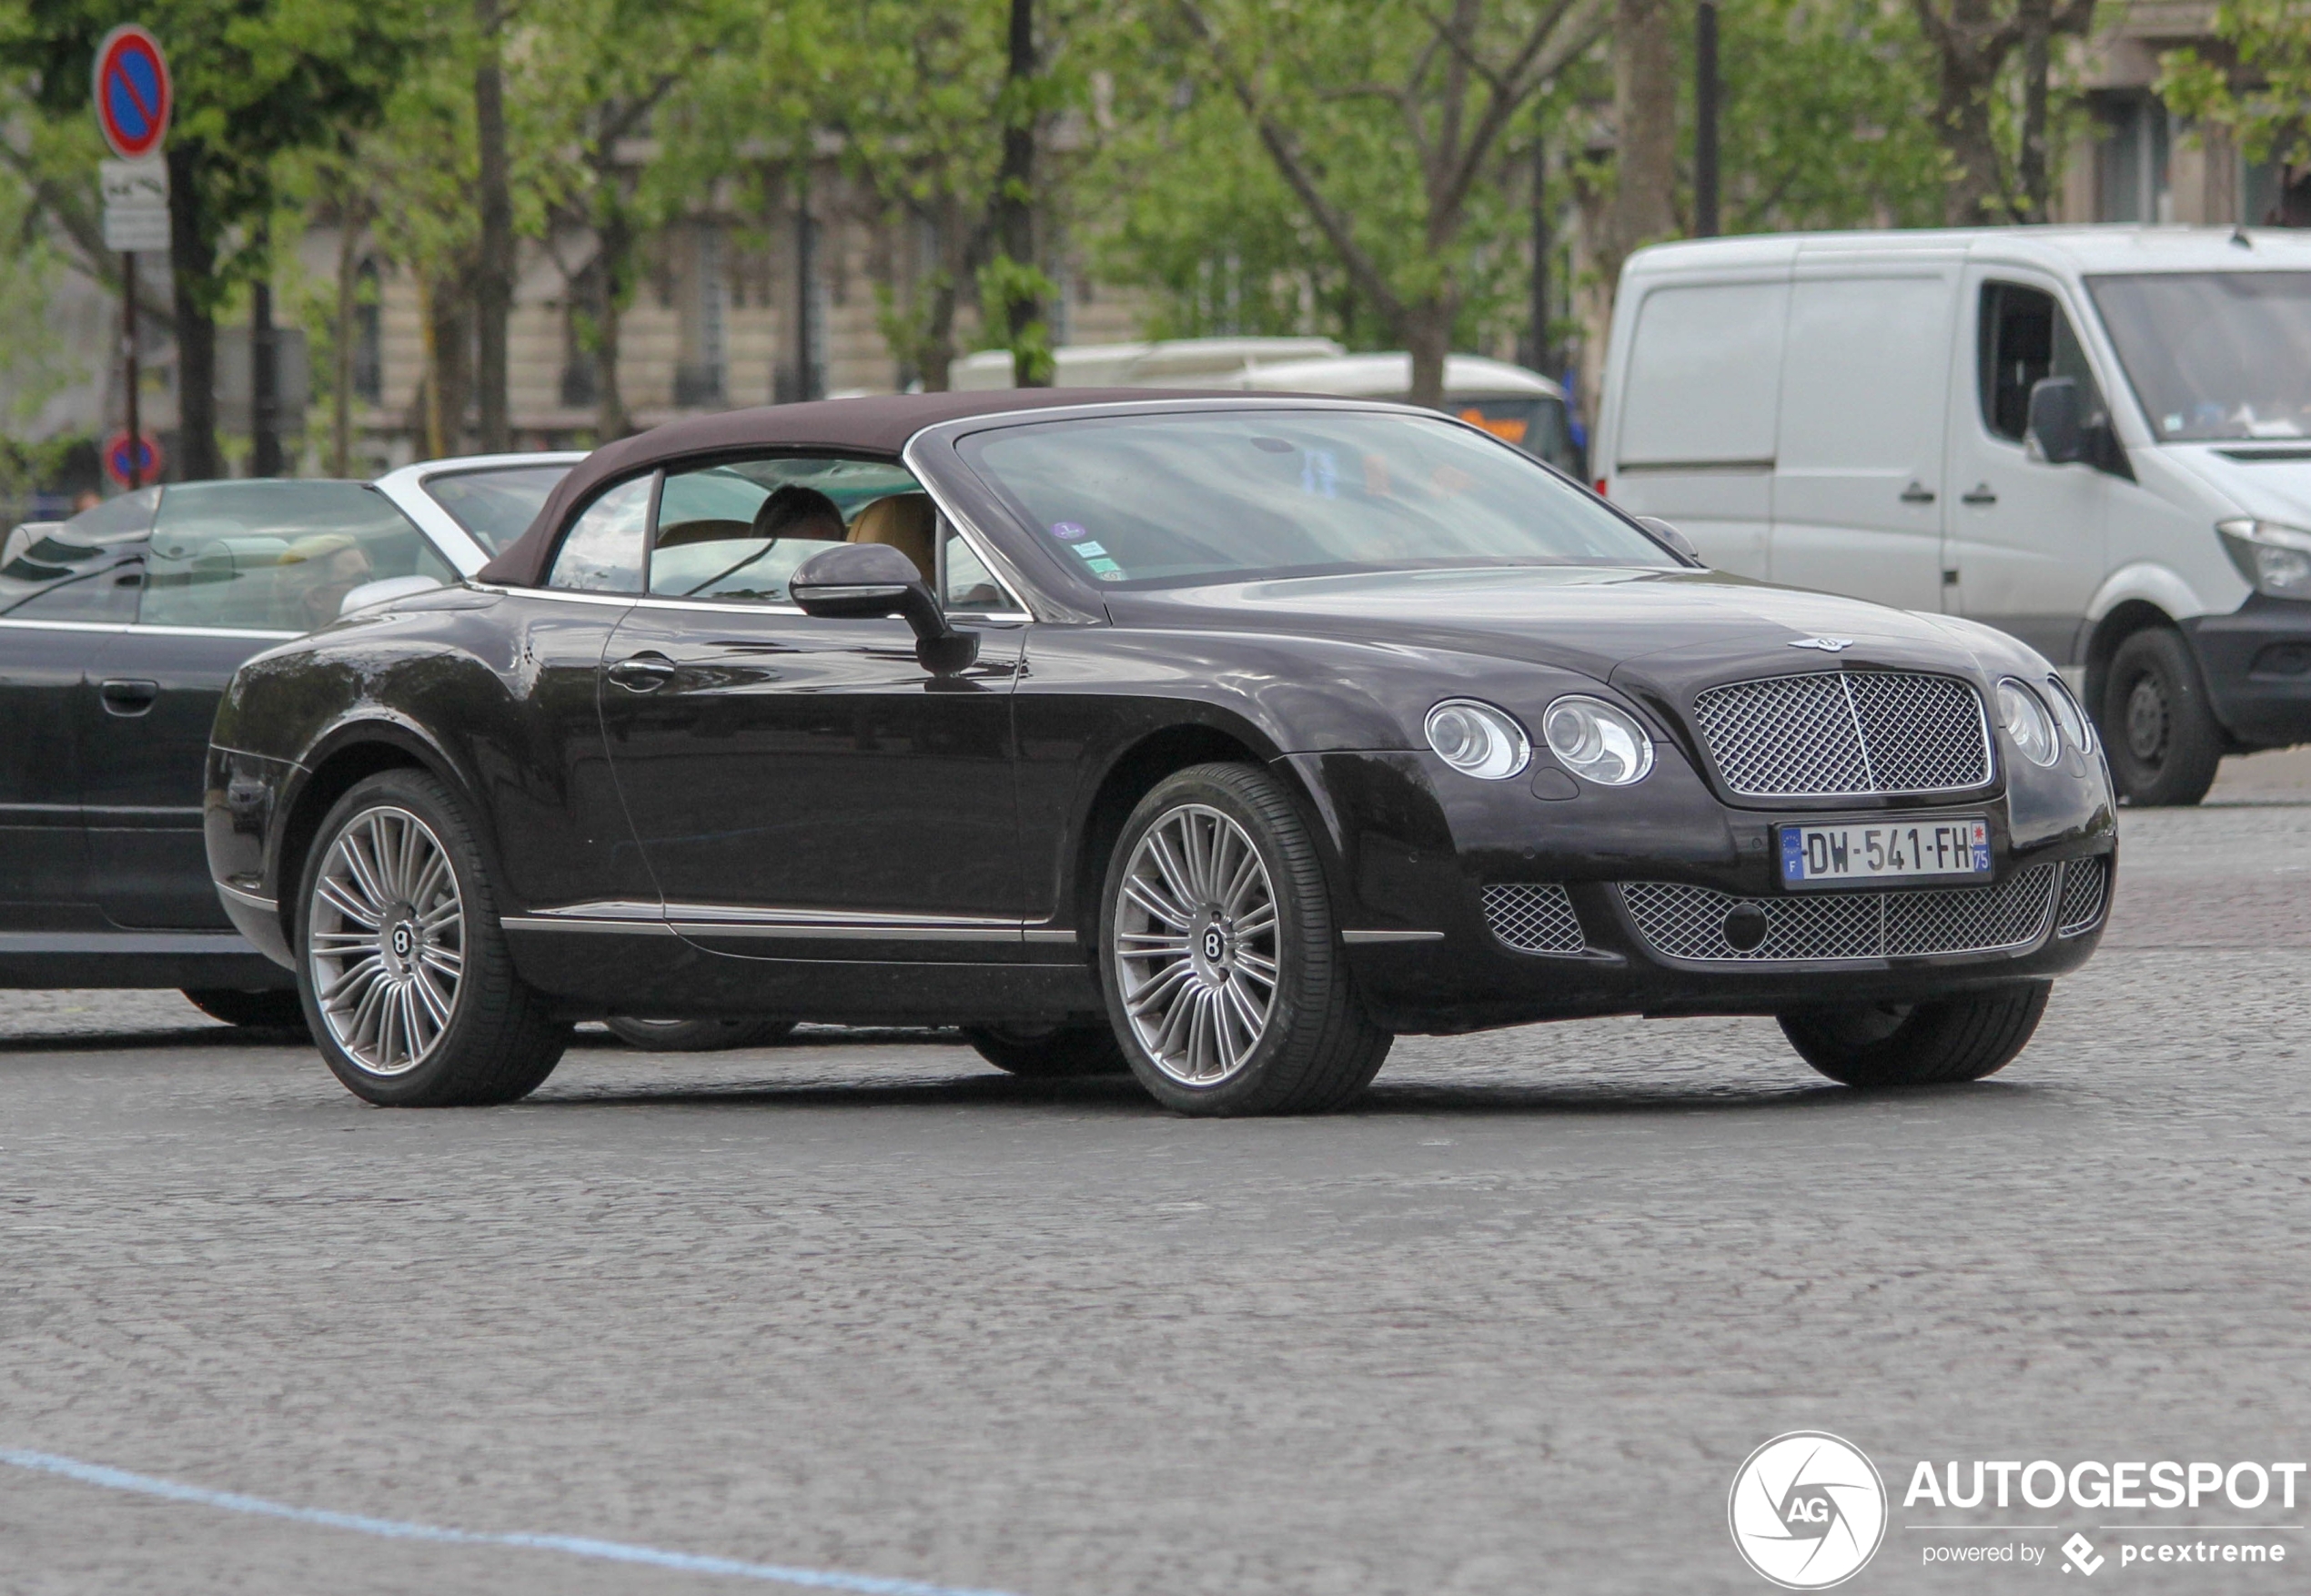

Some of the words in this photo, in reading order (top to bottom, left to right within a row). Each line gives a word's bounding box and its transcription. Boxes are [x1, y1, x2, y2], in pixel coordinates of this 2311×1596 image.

[1807, 827, 1970, 874] DW-541-FH
[1974, 850, 1989, 870] 75
[1789, 861, 1796, 873] F
[1206, 934, 1220, 957] B
